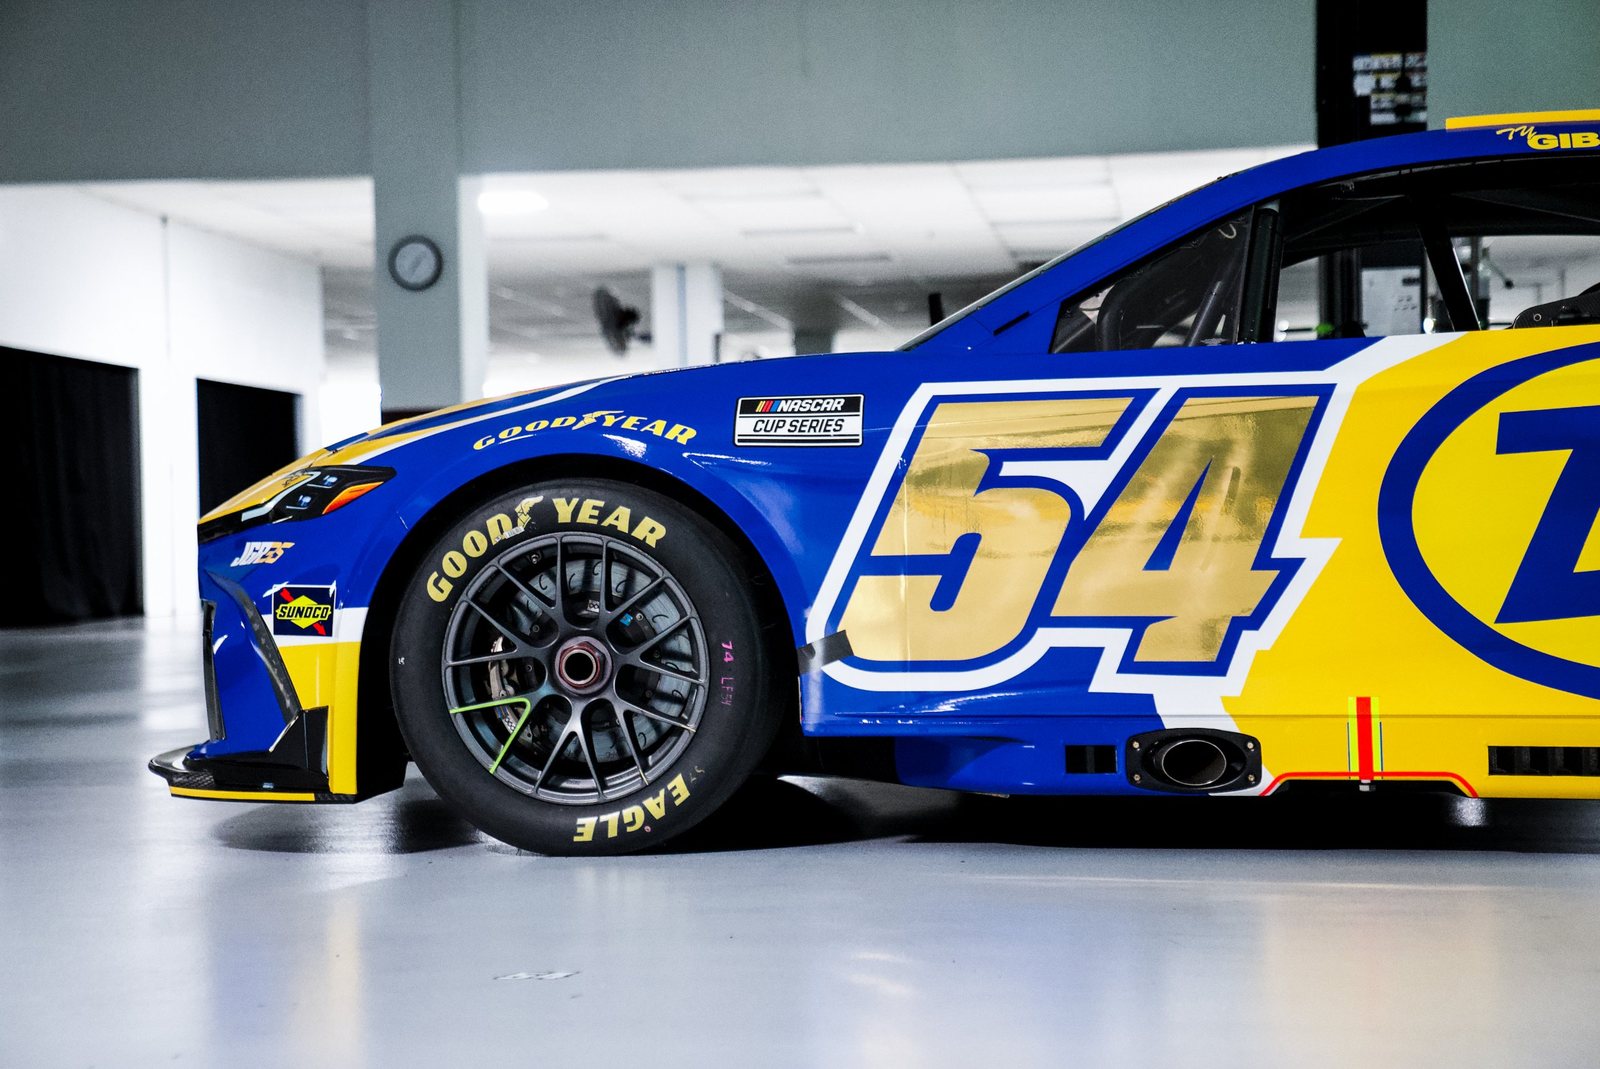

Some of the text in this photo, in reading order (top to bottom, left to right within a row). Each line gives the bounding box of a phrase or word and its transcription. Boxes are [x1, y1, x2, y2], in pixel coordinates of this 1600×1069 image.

[777, 398, 846, 413] NASCAR
[753, 418, 845, 433] CUP SERIES
[836, 395, 1320, 662] 54
[278, 606, 329, 618] SUNOCO
[573, 773, 691, 842] EAGLE
